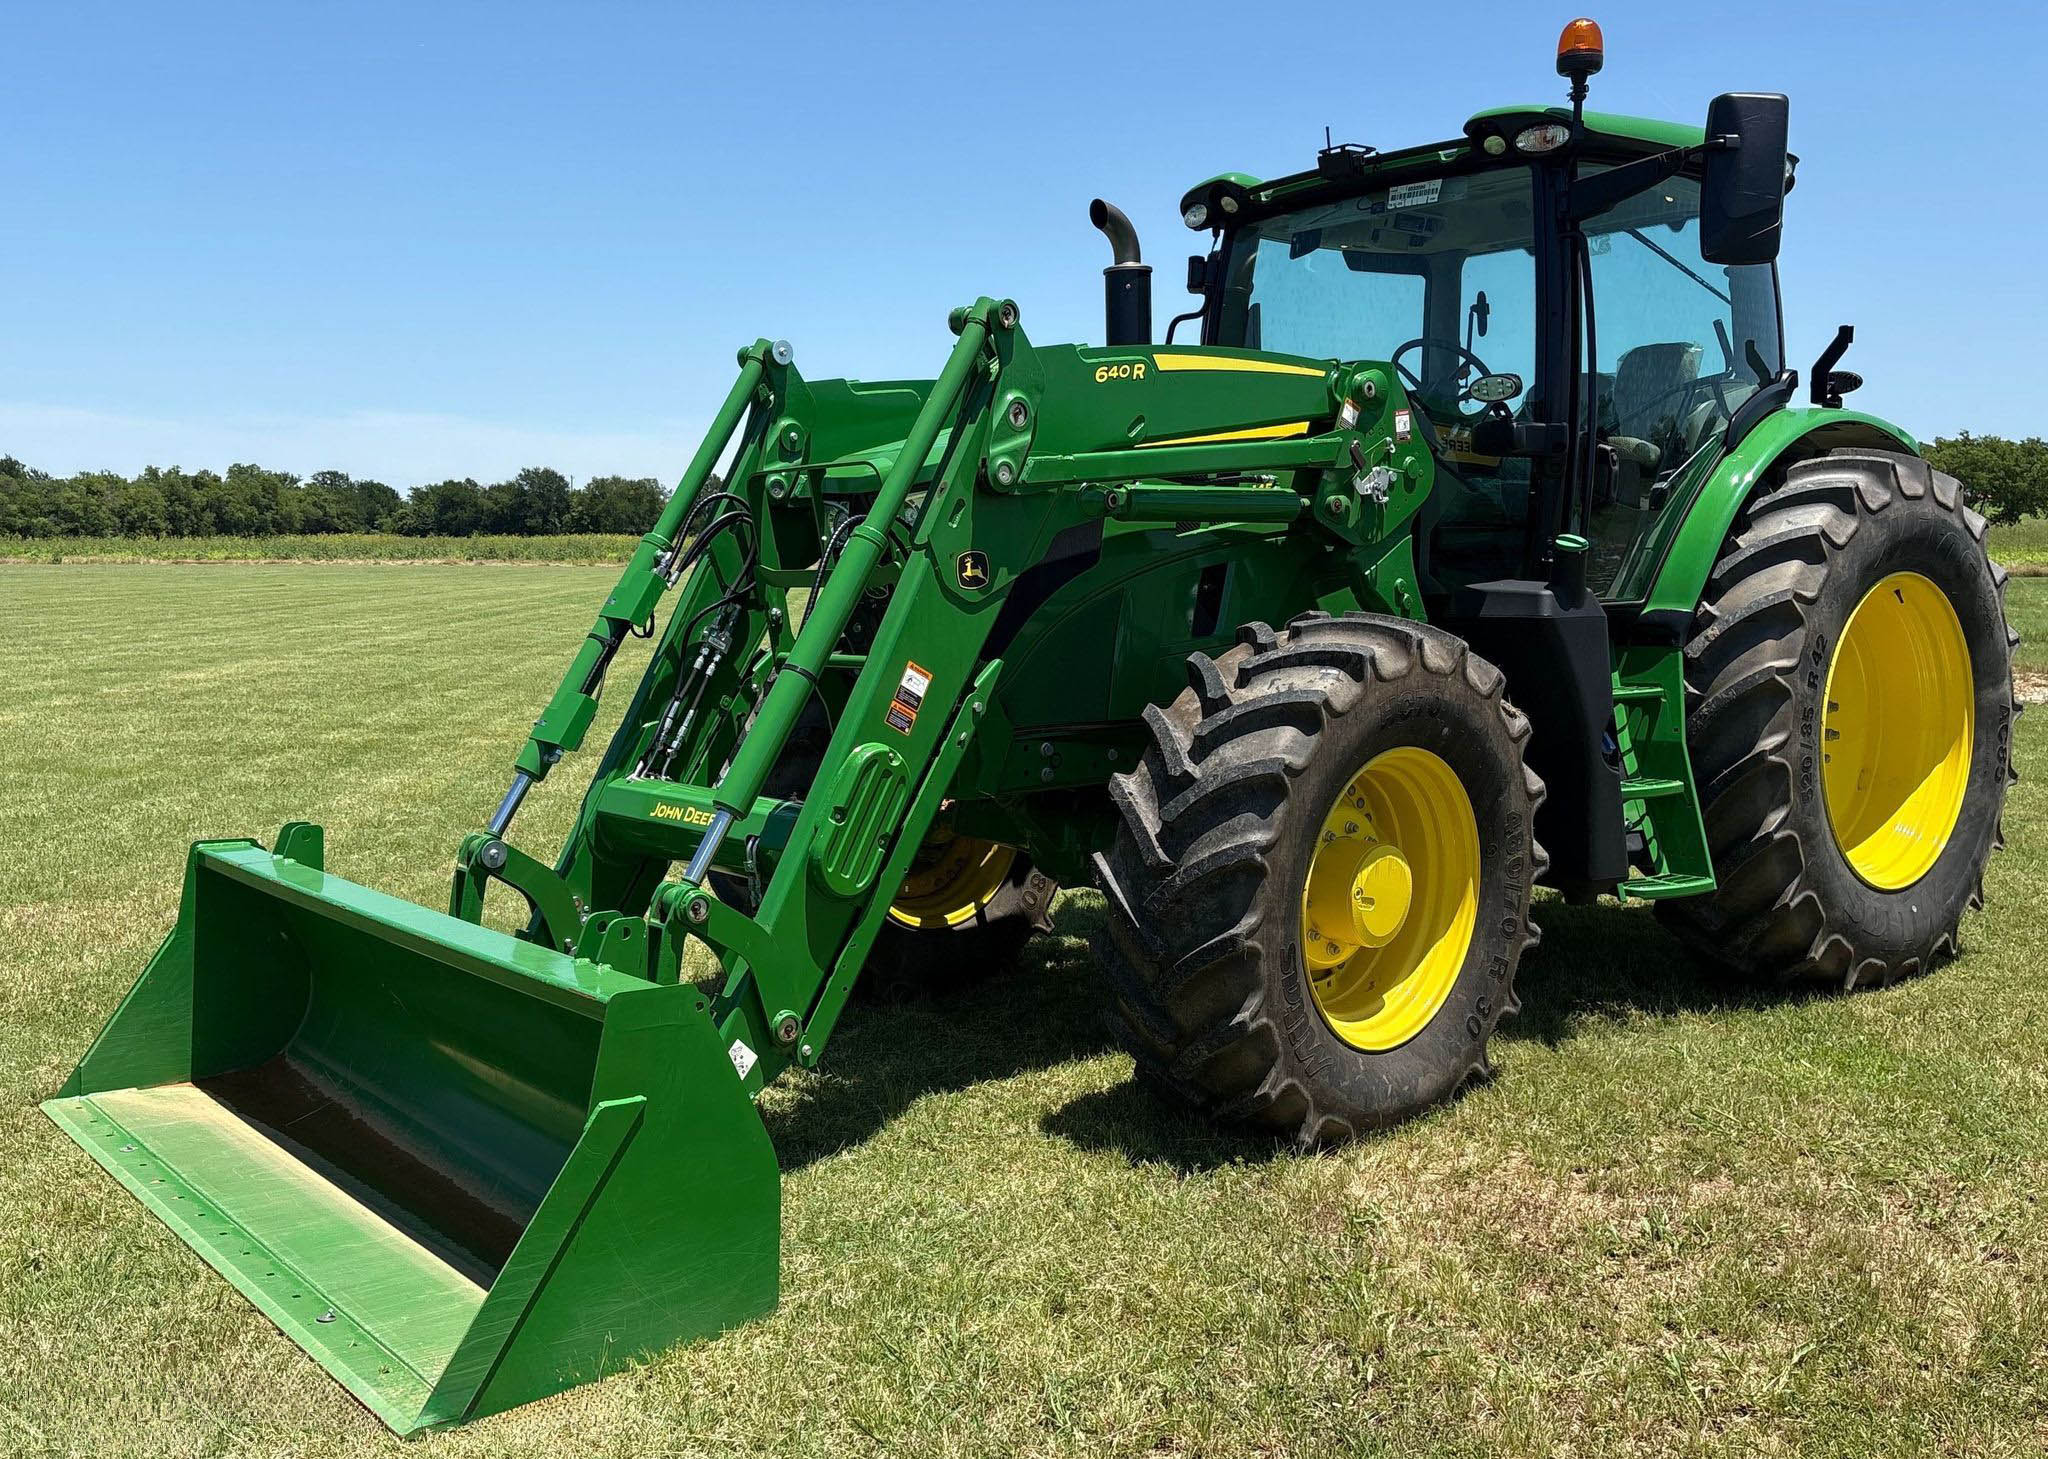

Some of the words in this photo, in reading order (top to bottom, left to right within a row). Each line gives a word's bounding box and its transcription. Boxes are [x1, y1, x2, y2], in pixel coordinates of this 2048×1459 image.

[1095, 364, 1130, 383] 640
[1132, 363, 1146, 380] R
[1811, 633, 1828, 667] 42
[650, 802, 685, 820] JOHN
[683, 806, 717, 826] DEE
[1502, 809, 1525, 940] 480/70
[1487, 954, 1510, 984] R
[1465, 995, 1492, 1041] 30
